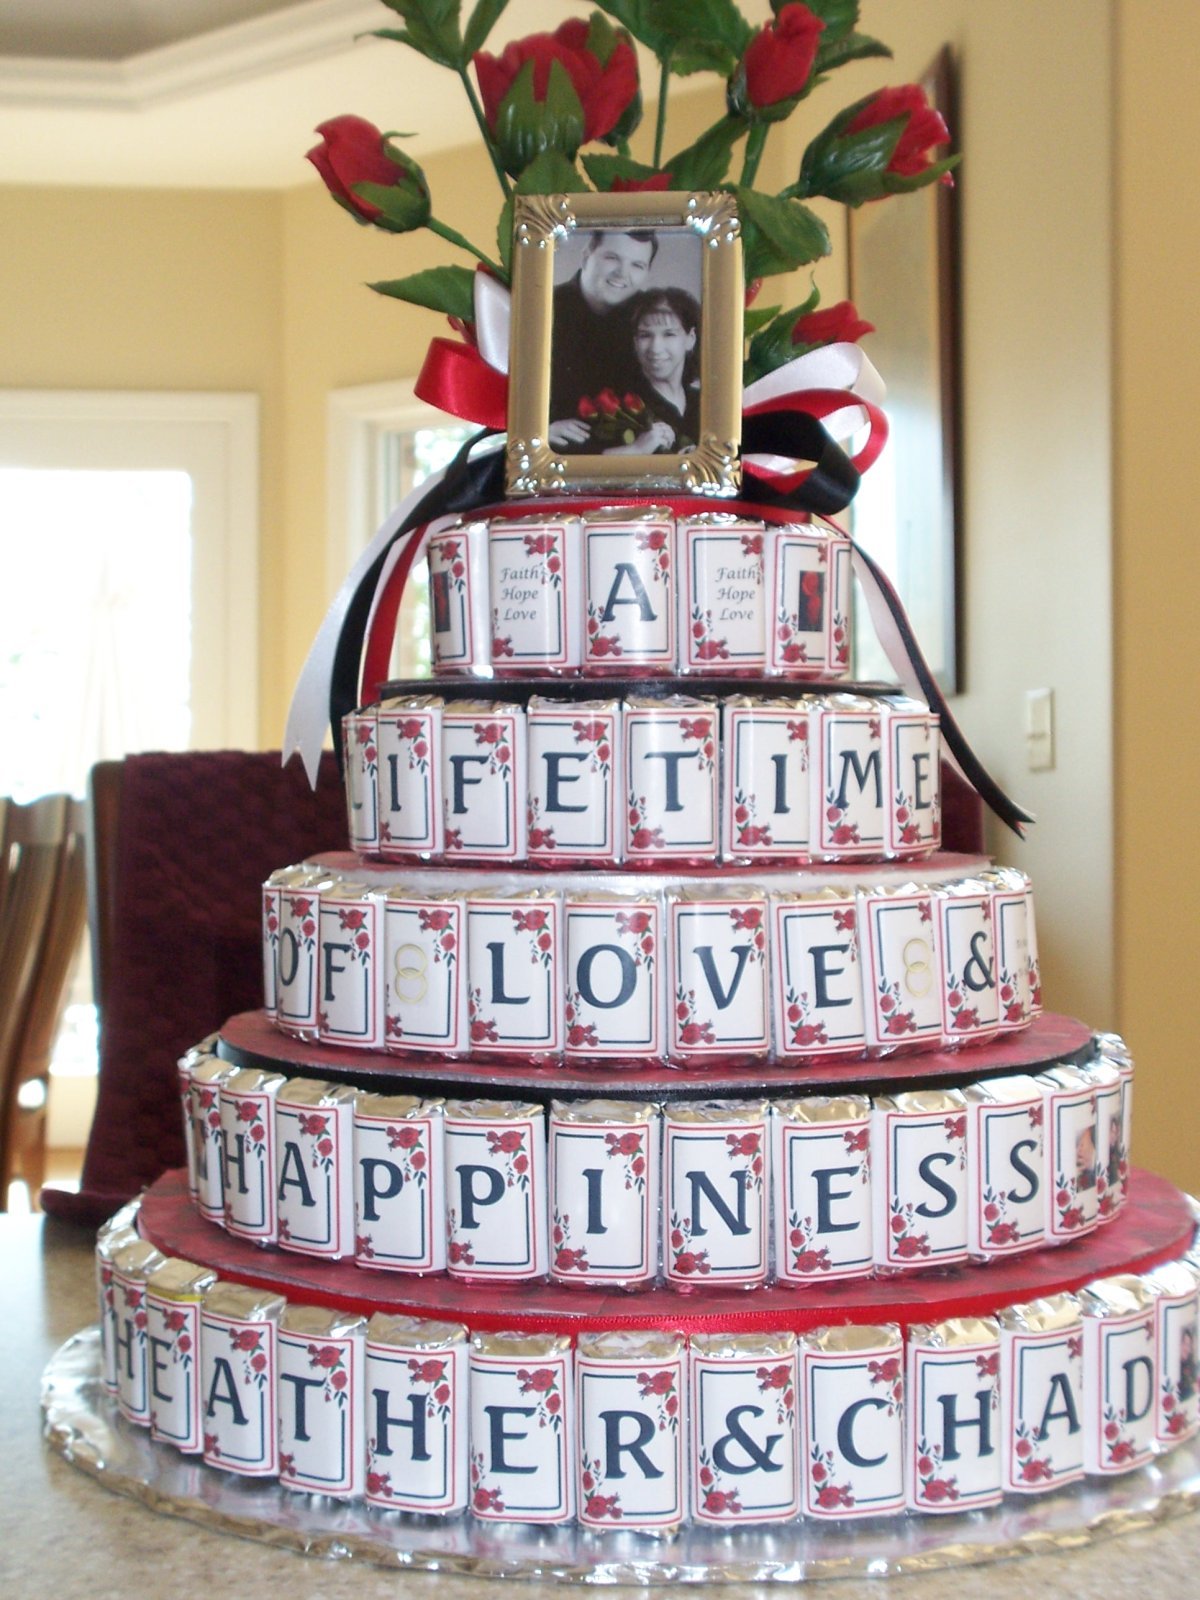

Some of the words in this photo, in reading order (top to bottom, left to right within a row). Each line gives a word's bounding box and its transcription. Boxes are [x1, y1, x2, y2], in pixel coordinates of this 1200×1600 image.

[499, 566, 540, 582] Faith
[715, 566, 757, 582] Faith
[501, 587, 539, 604] Hope
[601, 562, 658, 622] A
[717, 587, 756, 604] Hope
[503, 608, 537, 621] Love
[719, 608, 754, 621] Love
[352, 749, 932, 814] IFETIME
[279, 927, 356, 1002] OF
[488, 941, 854, 1011] LOVE
[963, 930, 996, 992] &
[222, 1129, 1040, 1236] HAPPINESS
